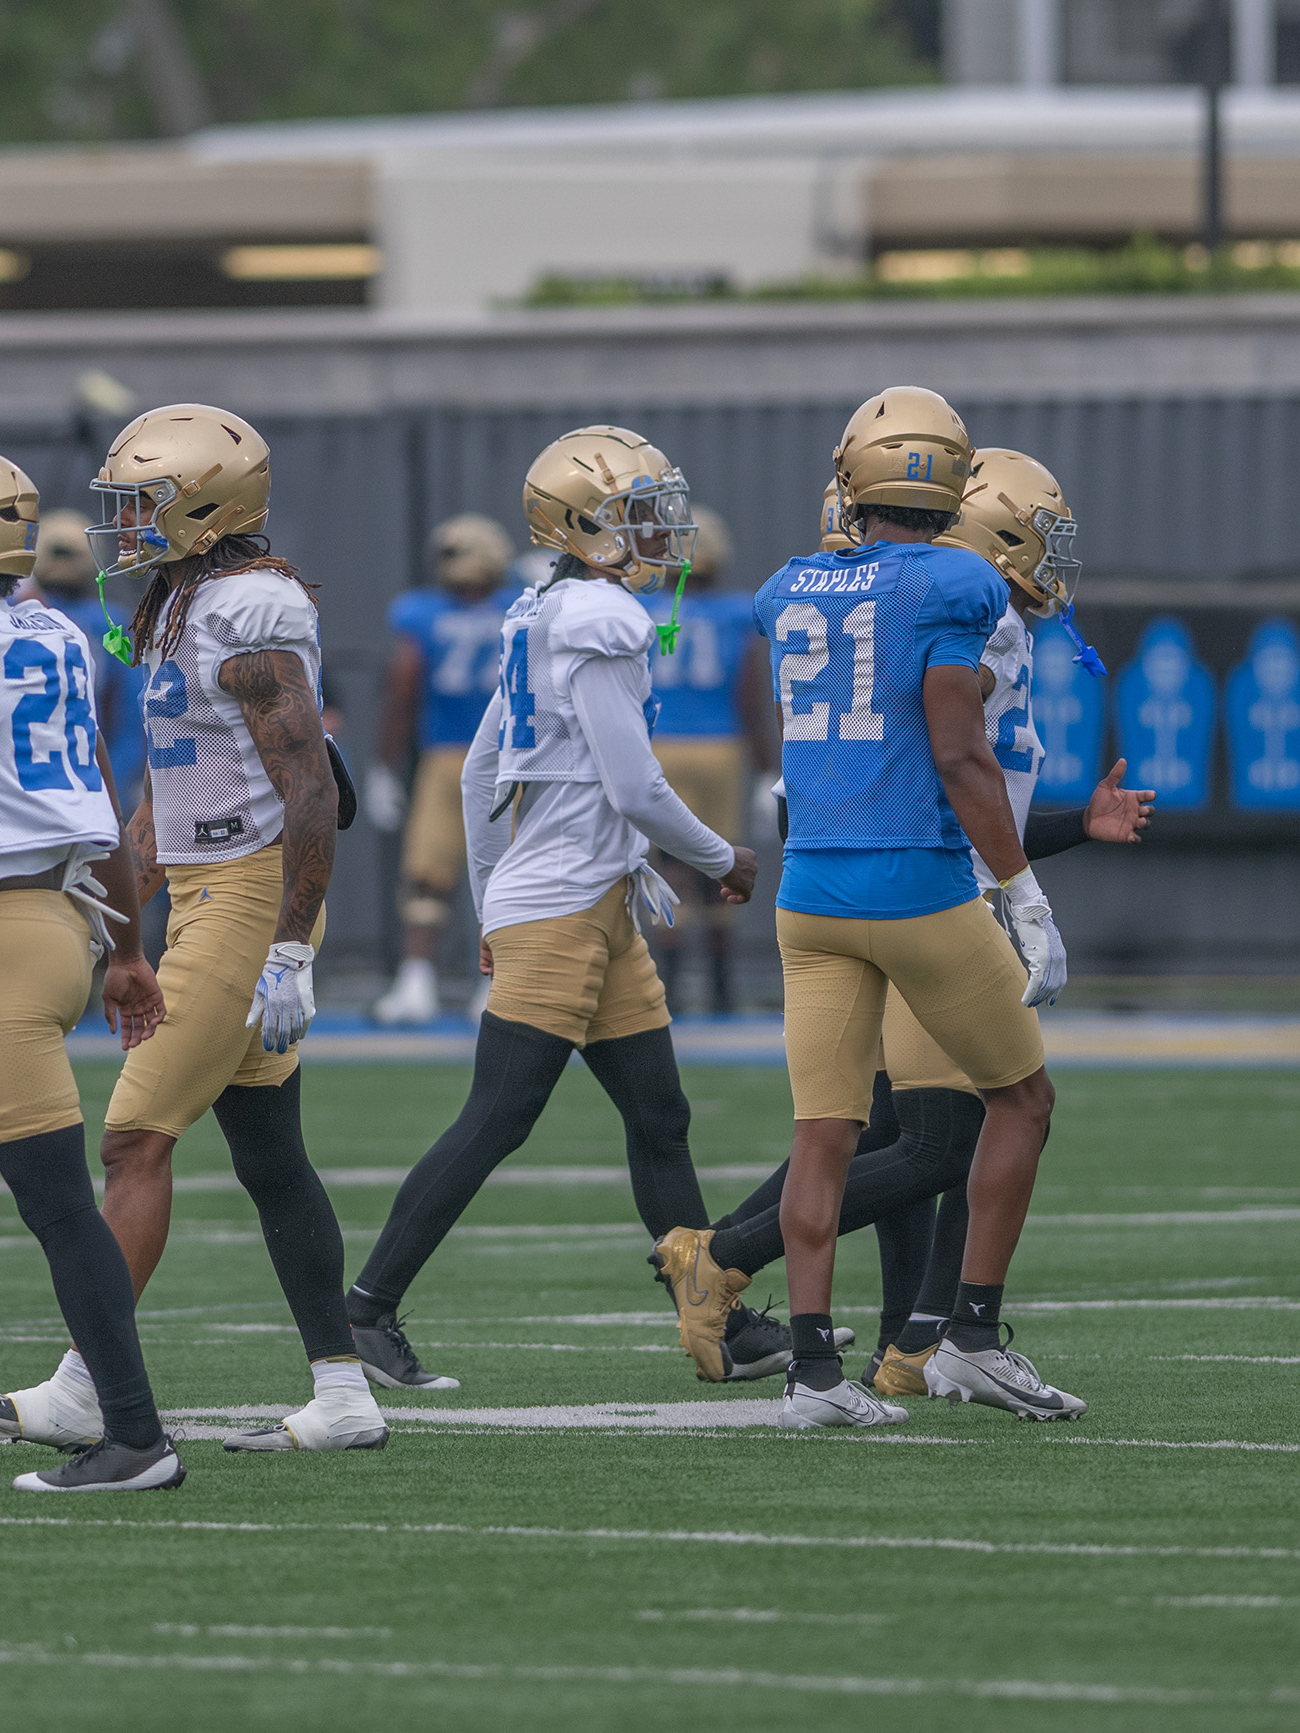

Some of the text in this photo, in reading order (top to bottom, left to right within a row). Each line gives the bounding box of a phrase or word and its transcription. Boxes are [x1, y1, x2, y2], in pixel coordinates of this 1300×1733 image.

[907, 452, 933, 480] 21
[826, 507, 835, 532] 3
[24, 523, 39, 551] 2
[789, 561, 880, 592] STAPLES
[775, 600, 884, 741] 21
[3, 639, 102, 792] 28
[139, 660, 197, 769] 2
[230, 821, 239, 830] M
